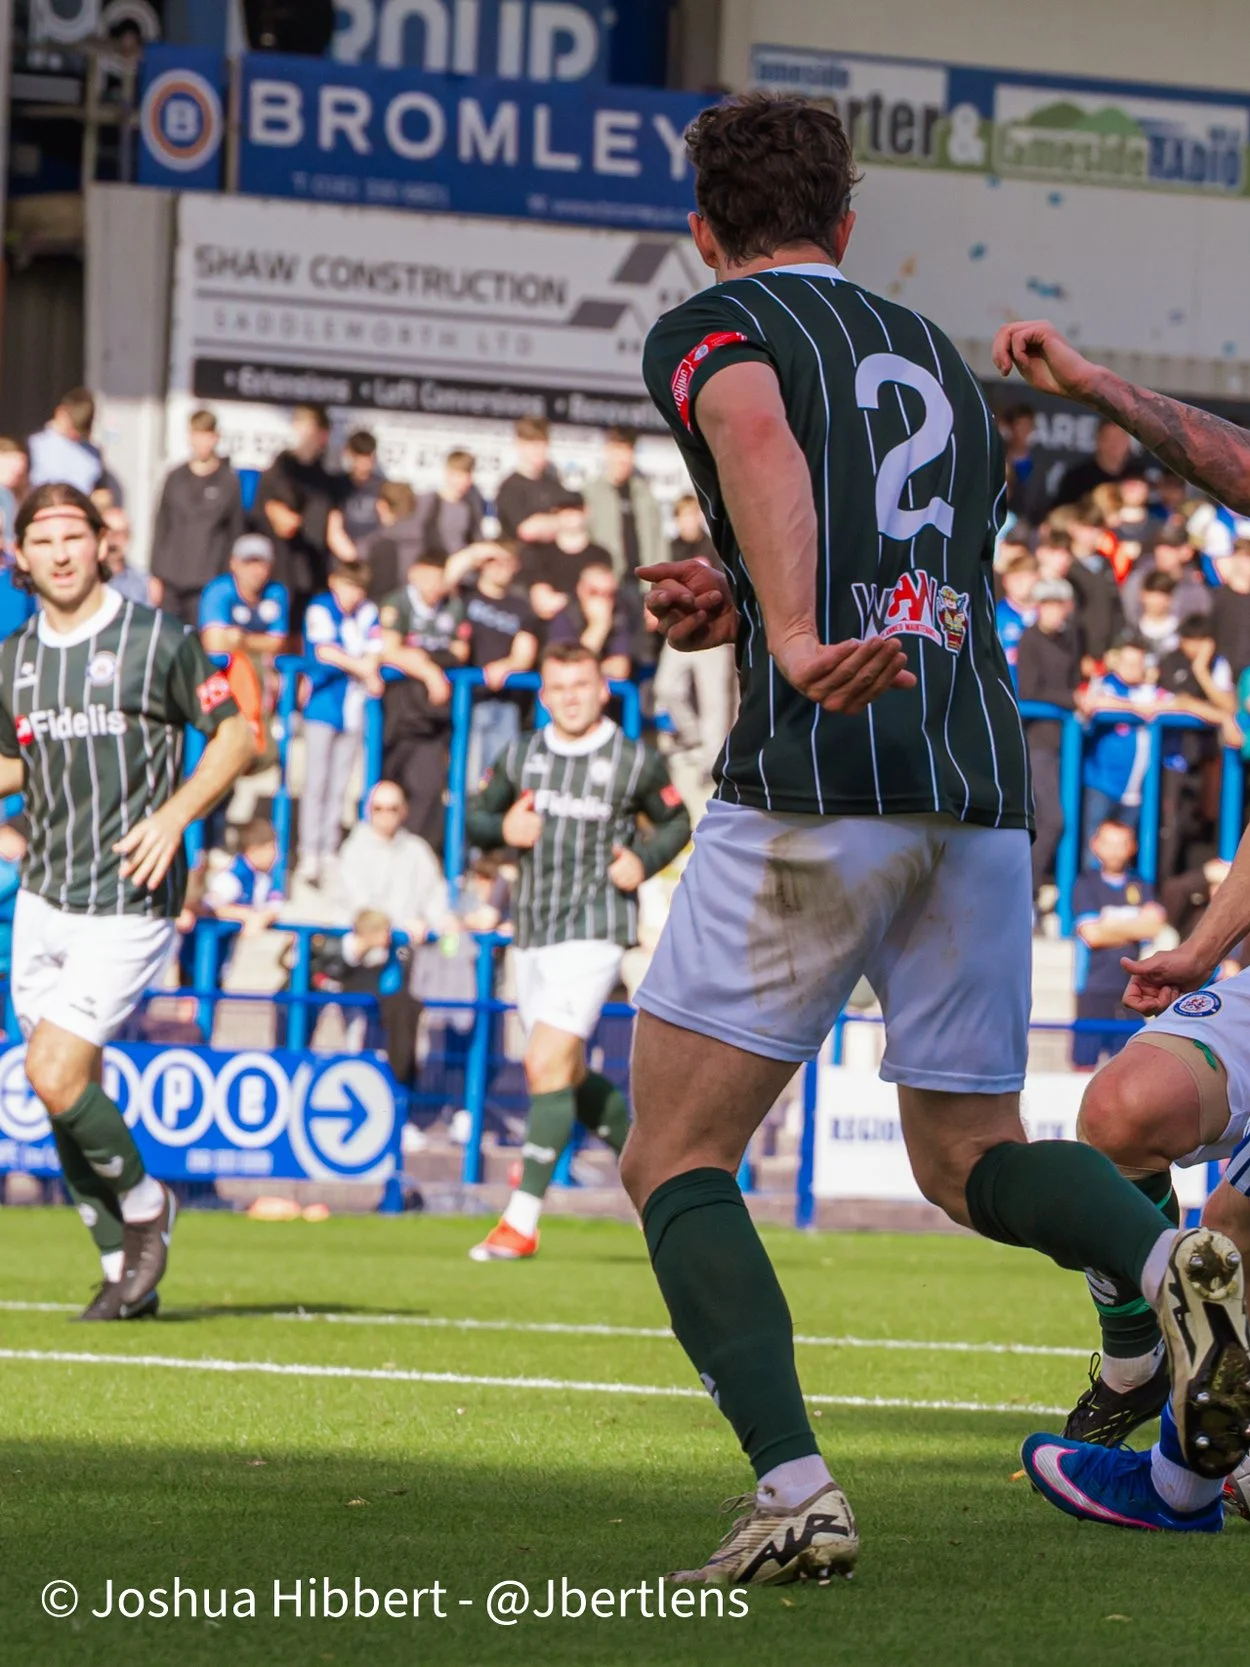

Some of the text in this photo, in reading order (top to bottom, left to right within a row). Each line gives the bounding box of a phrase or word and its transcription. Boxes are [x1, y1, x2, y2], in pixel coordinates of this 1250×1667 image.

[164, 99, 199, 141] B
[249, 79, 692, 182] BROMLEY
[847, 91, 939, 158] rter
[195, 244, 568, 307] SHAW CONSTRUCTION
[213, 307, 535, 358] SADDLEWORTH LTD
[854, 352, 955, 541] 2
[29, 703, 128, 741] Fidelis
